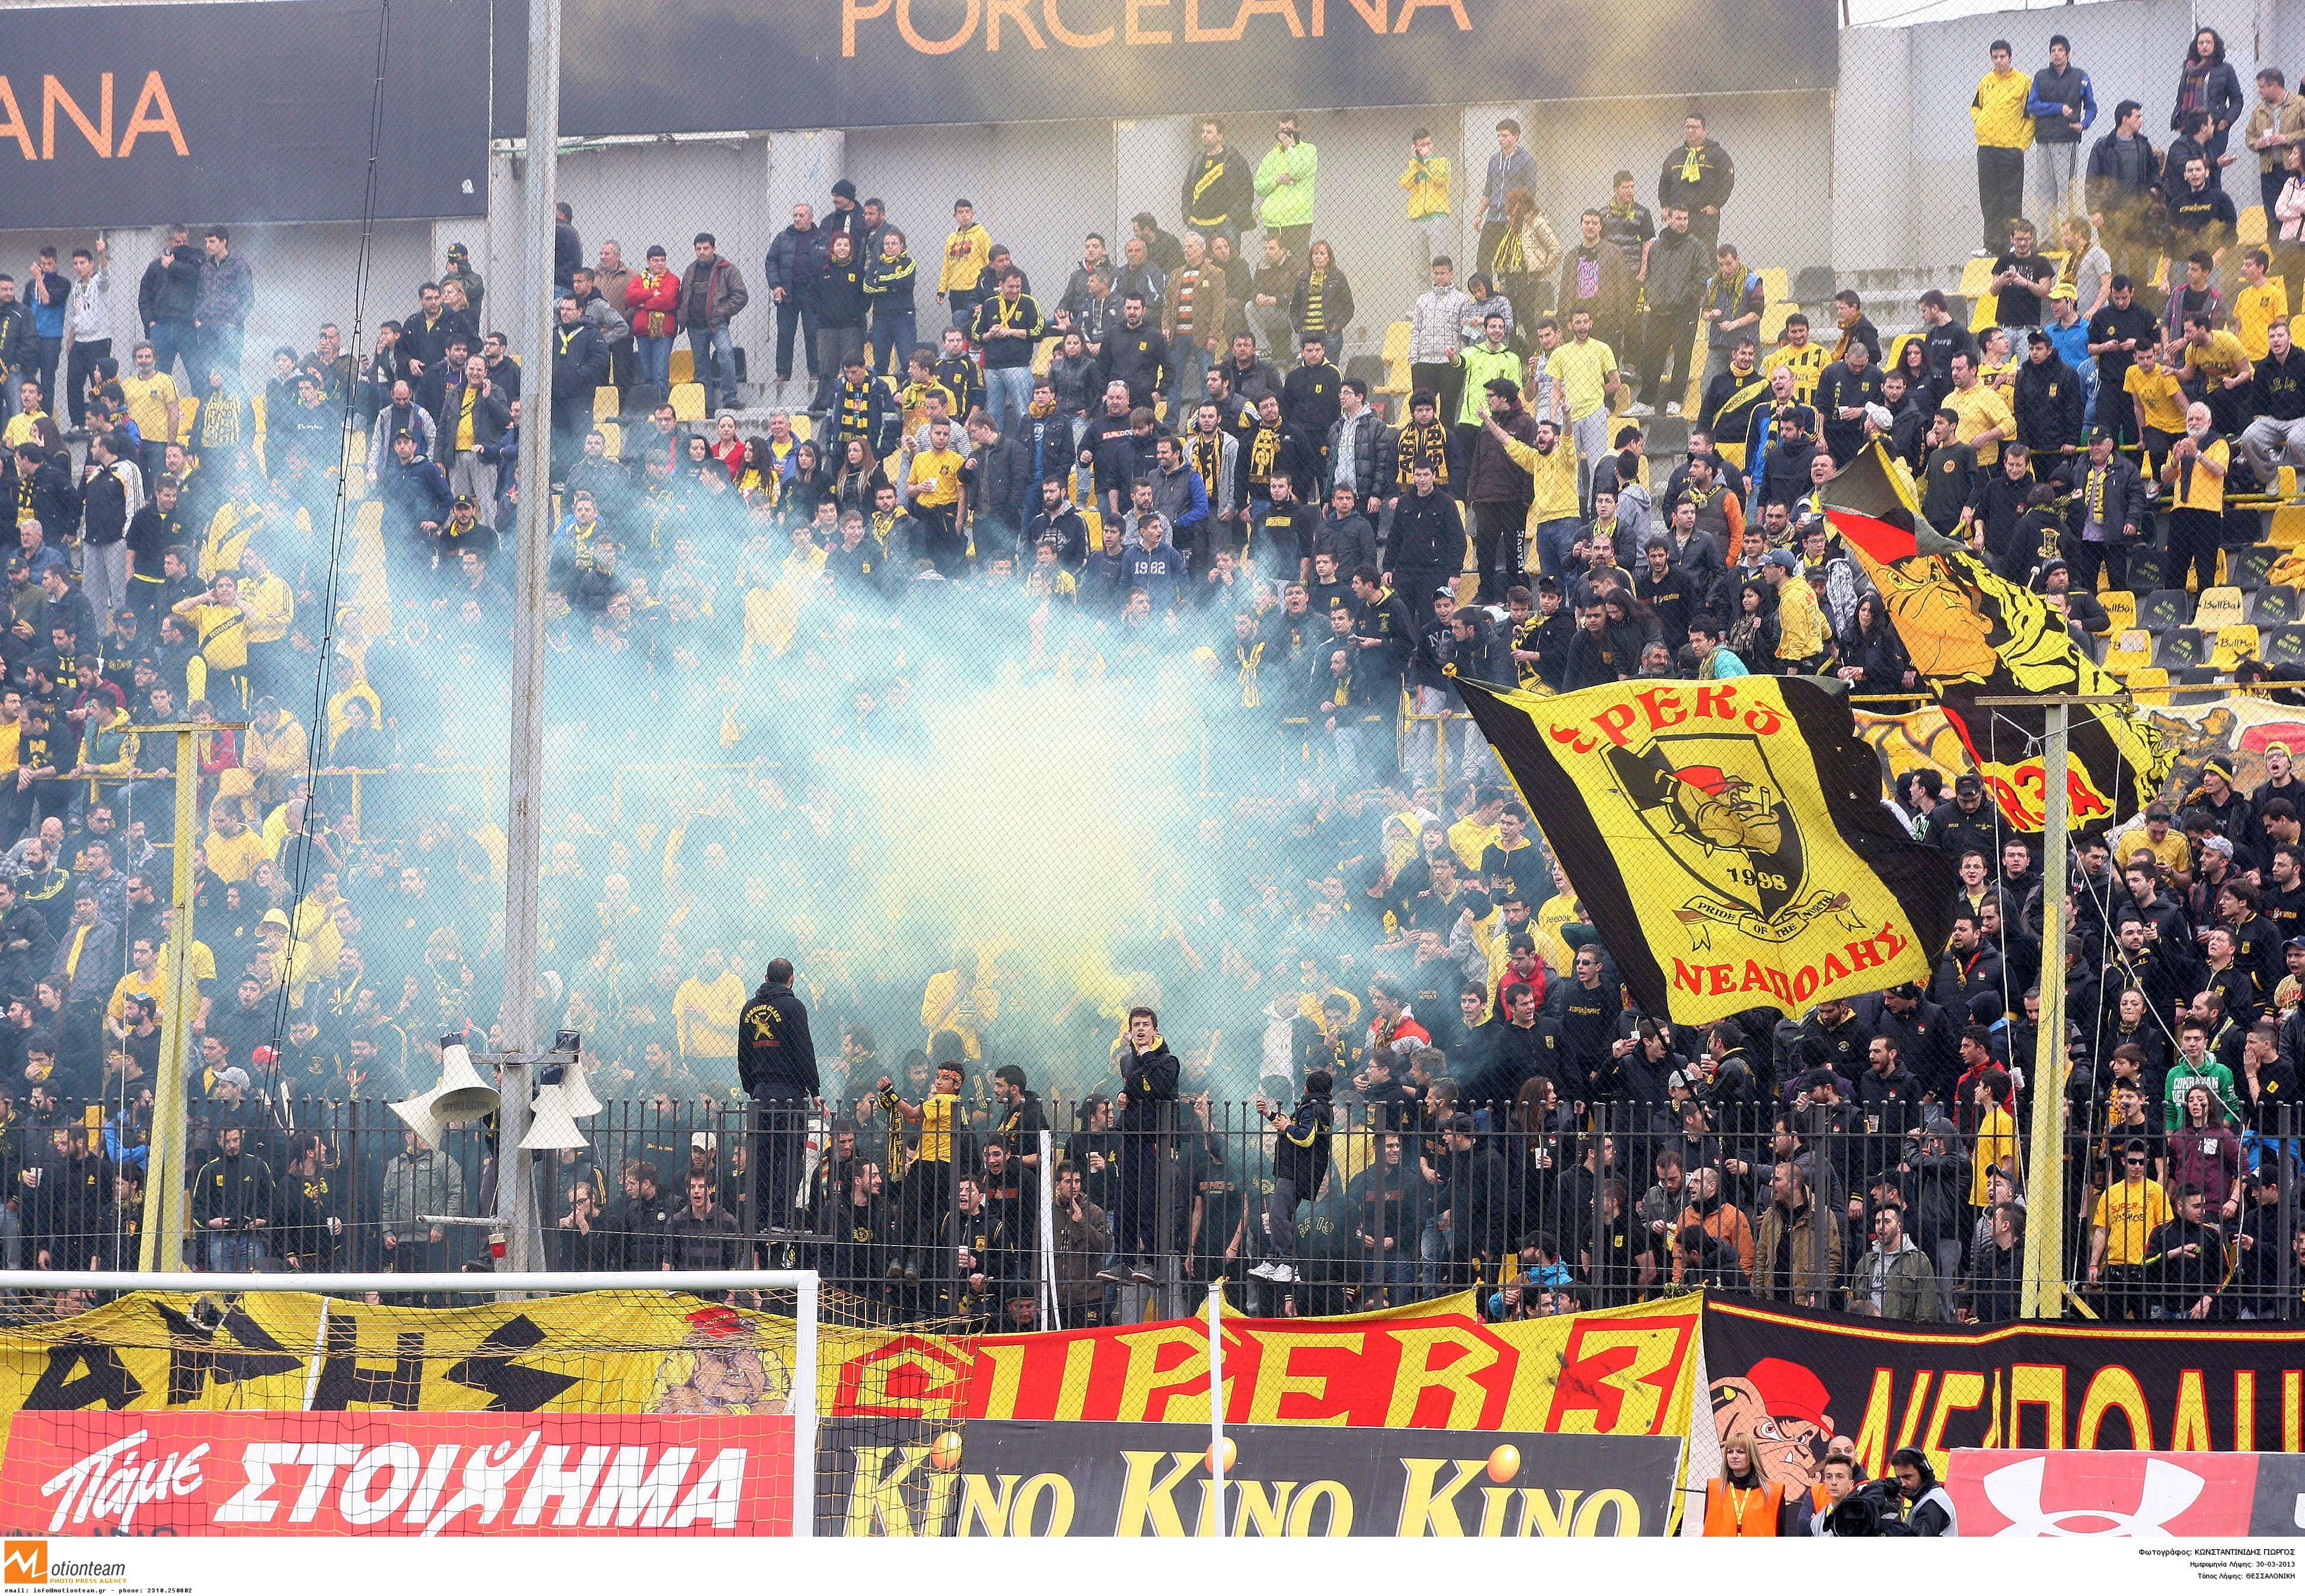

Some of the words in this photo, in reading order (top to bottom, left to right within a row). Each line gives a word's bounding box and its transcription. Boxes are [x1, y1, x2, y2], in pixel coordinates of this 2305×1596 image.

[1726, 867, 1788, 891] 1998
[1697, 902, 1736, 921] PRIDE
[1753, 924, 1767, 935] OF
[1774, 924, 1798, 938] THE
[1803, 895, 1835, 922] NORTH
[836, 1317, 1500, 1430] SUPER
[41, 1429, 211, 1534] Πάμε
